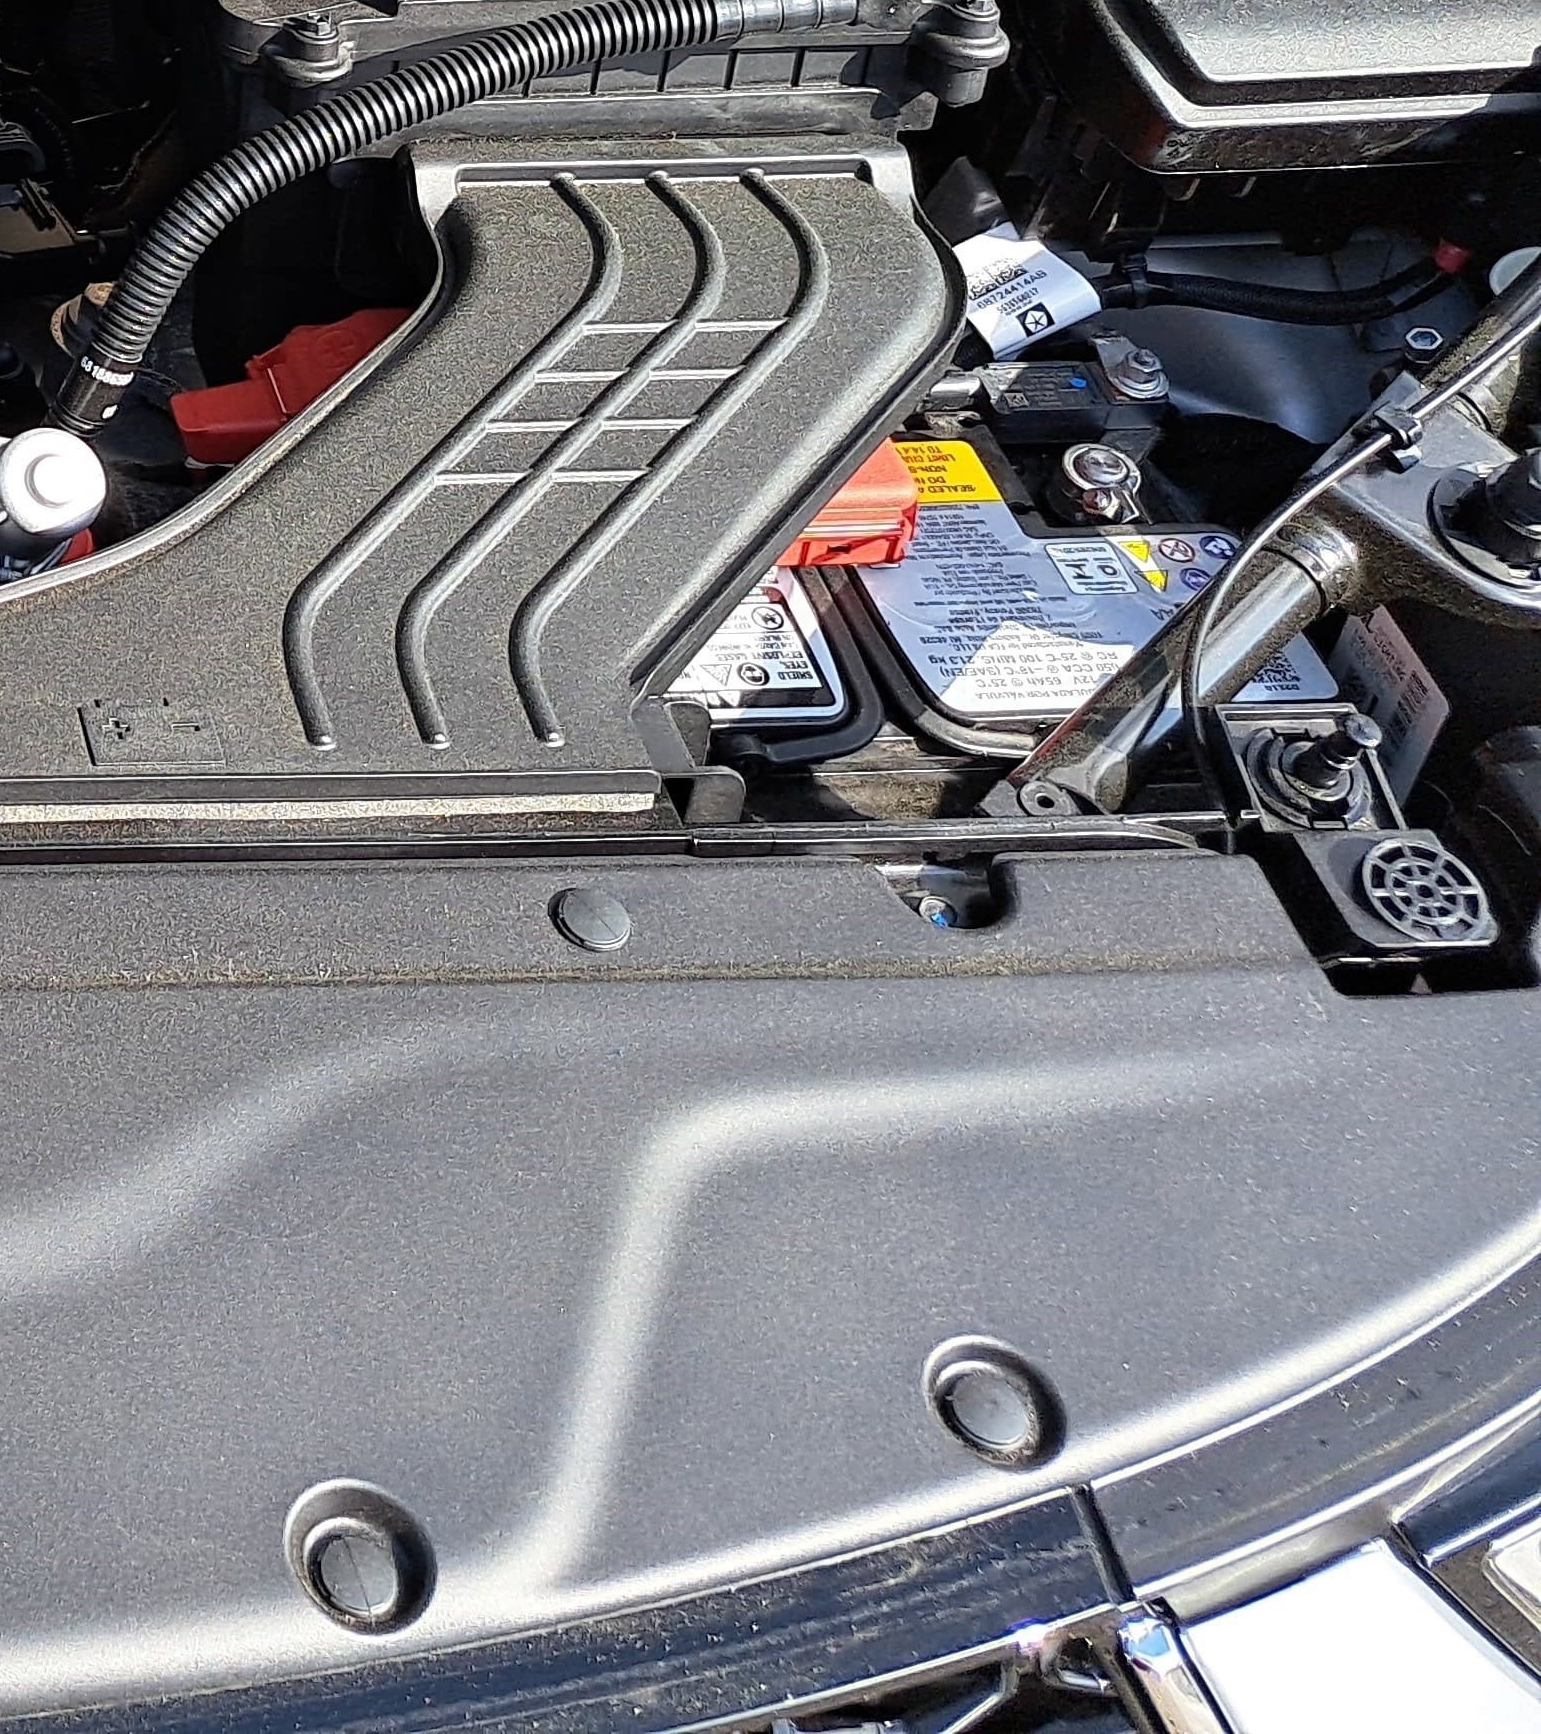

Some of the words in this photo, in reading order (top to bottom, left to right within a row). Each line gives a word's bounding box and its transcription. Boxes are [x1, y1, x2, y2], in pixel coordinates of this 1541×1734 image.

[928, 655, 946, 665] kg
[1061, 664, 1093, 675] CCA
[777, 671, 813, 680] SHIELD
